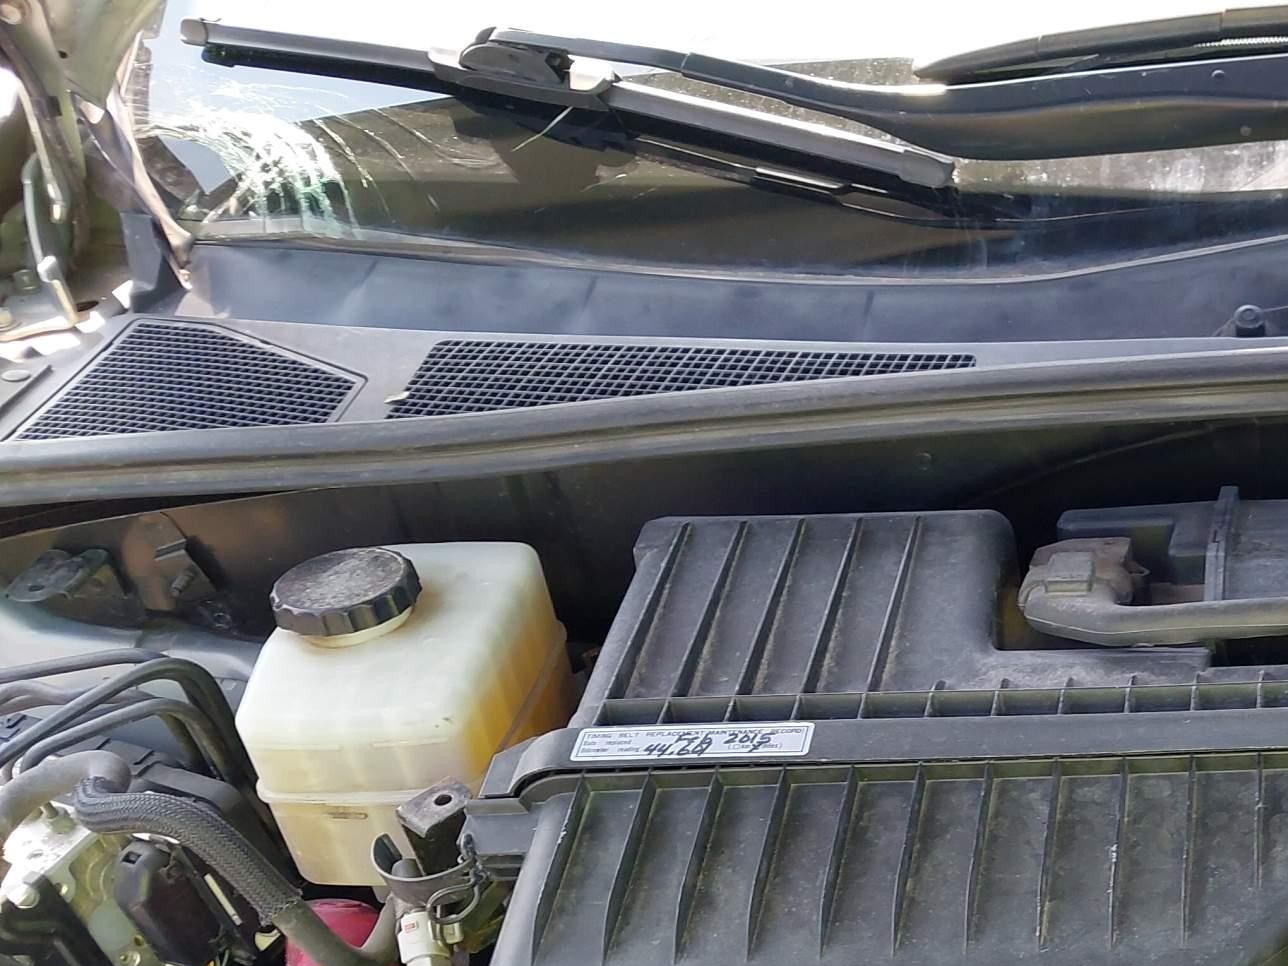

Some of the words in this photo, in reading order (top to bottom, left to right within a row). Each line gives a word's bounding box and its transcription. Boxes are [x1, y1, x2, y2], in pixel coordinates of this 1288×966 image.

[618, 731, 640, 739] BELT
[707, 727, 764, 736] MAINTENANCE
[723, 732, 776, 745] 2015
